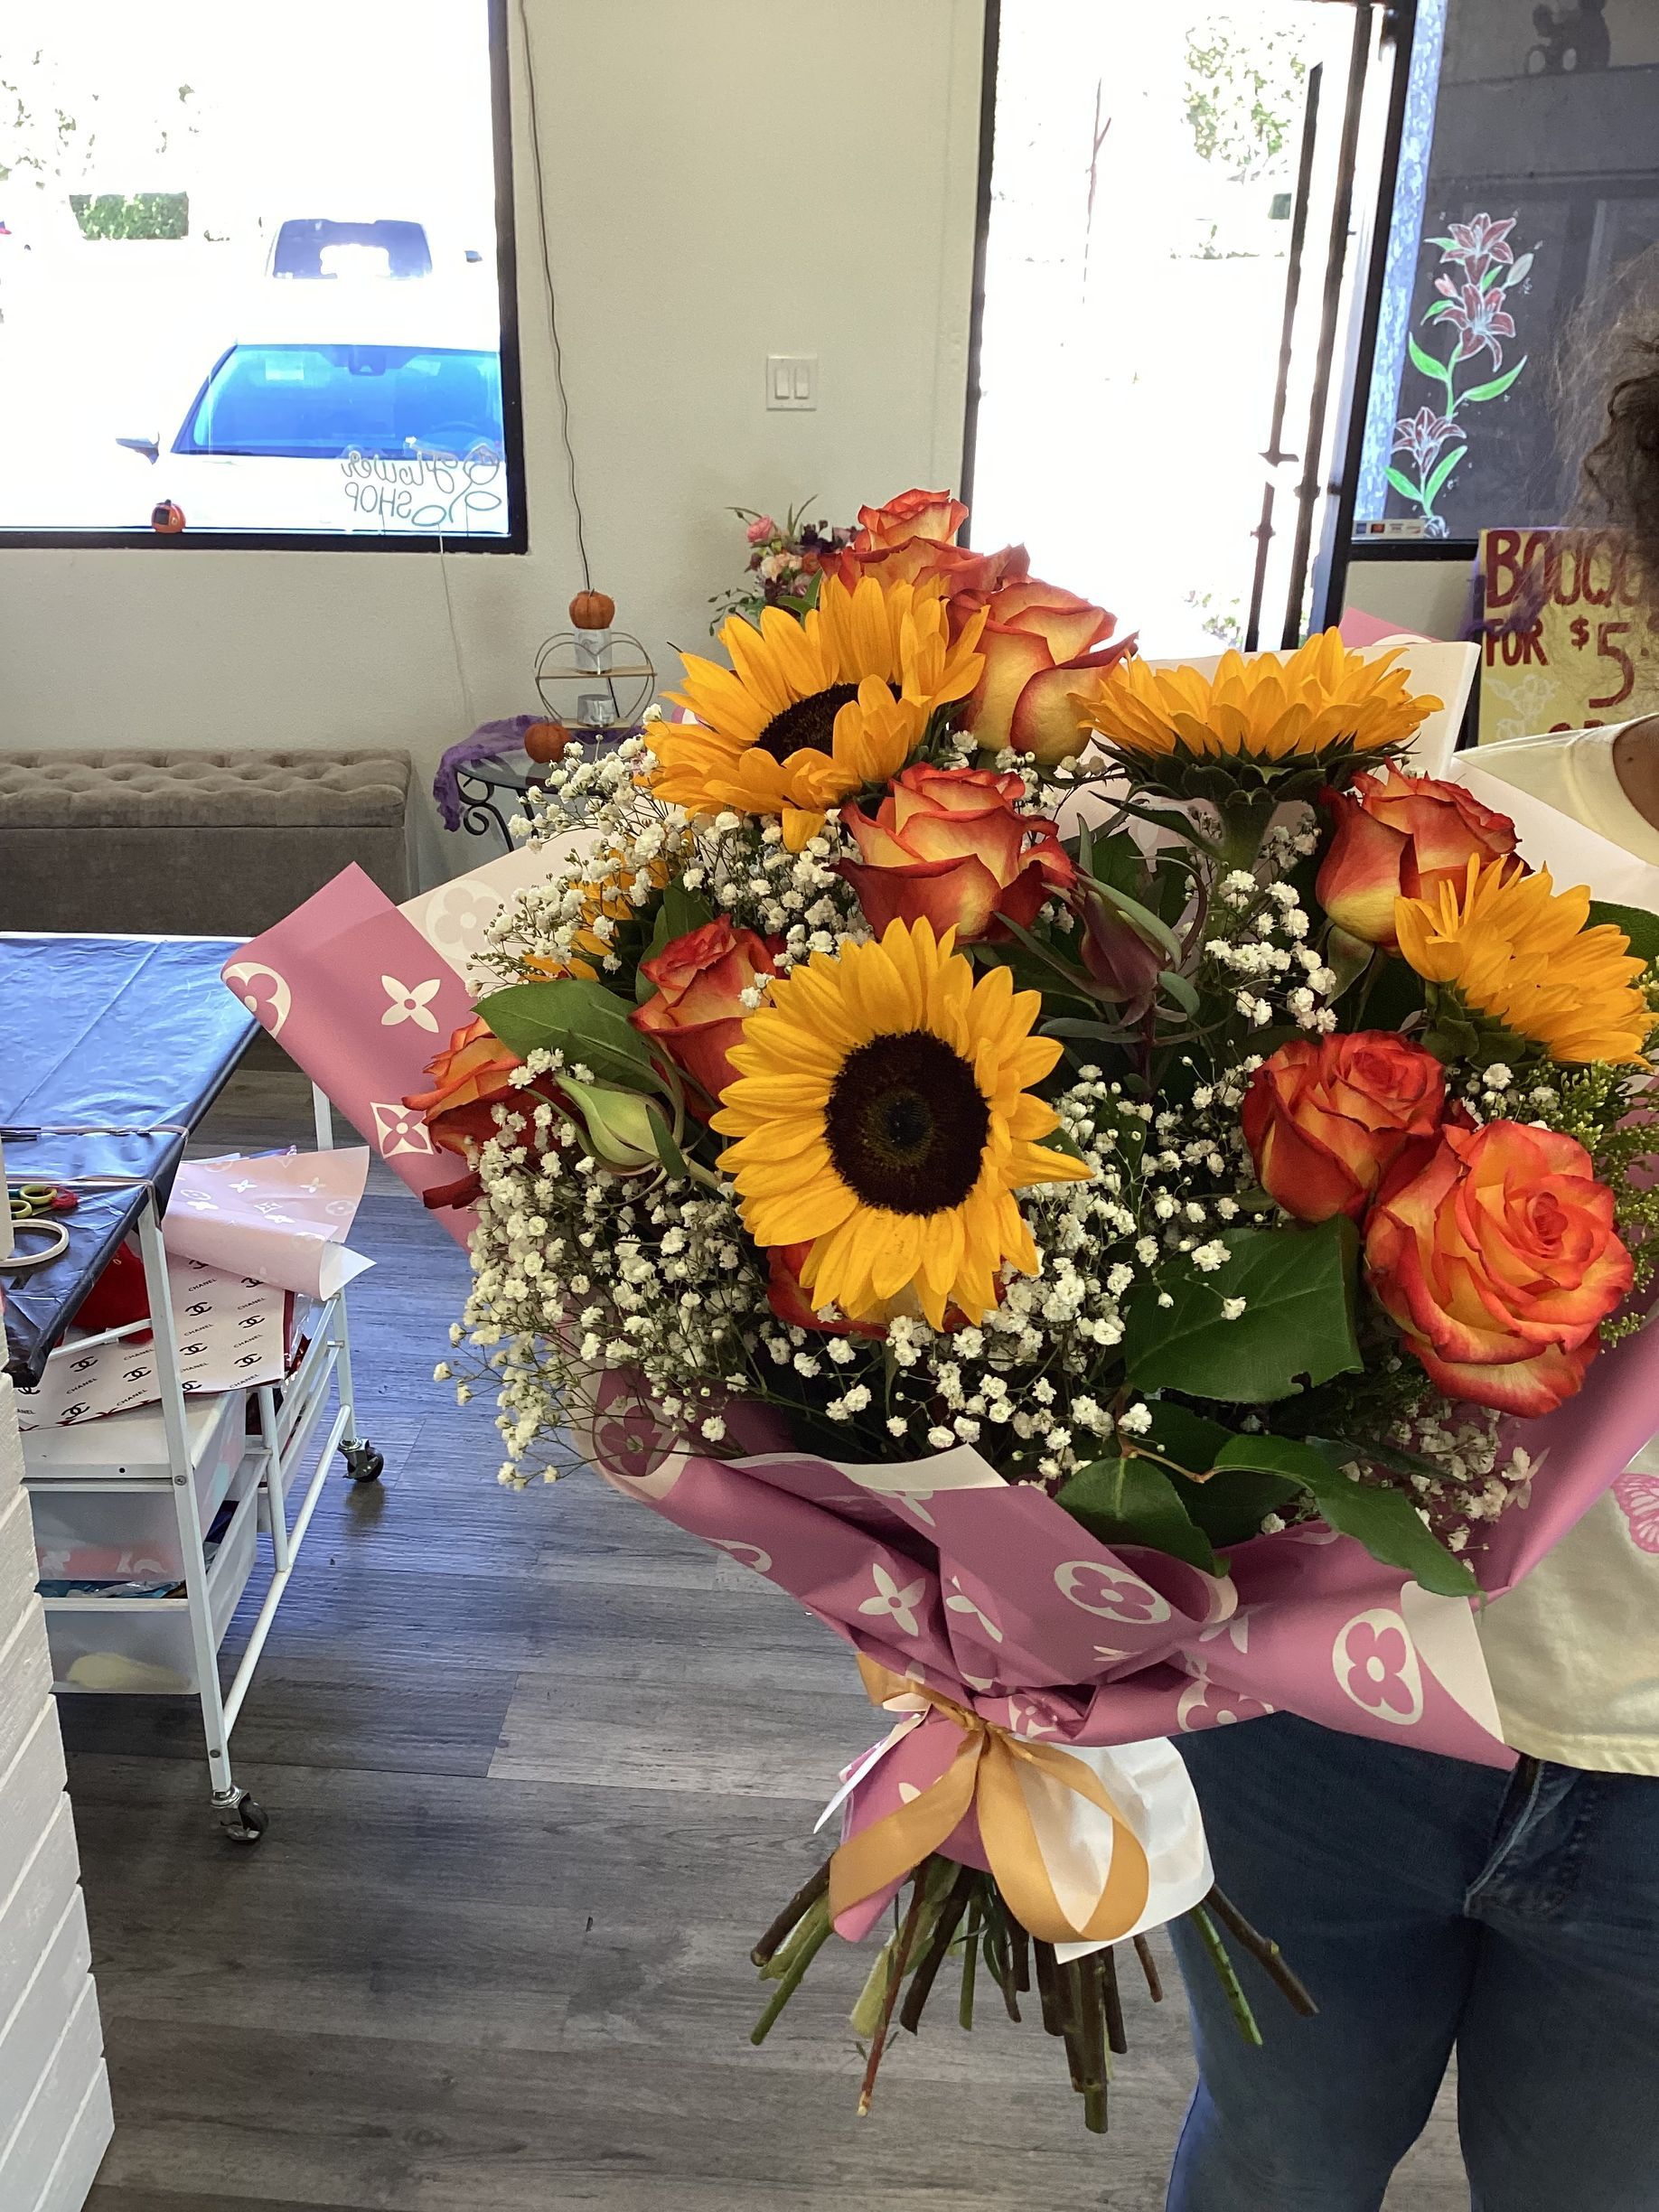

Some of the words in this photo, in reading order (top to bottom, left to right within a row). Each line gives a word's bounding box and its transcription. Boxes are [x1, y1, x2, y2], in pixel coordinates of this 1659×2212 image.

[1485, 618, 1550, 667] FOR
[188, 1279, 217, 1292] CHANEL
[237, 1297, 266, 1310] CHANEL
[183, 1324, 214, 1336] CHANEL
[233, 1334, 263, 1348] CHANEL
[124, 1348, 155, 1361] CHANEL
[66, 1378, 98, 1394] CHANEL
[230, 1373, 259, 1389] CHANEL
[116, 1389, 147, 1406] CHANEL
[16, 1408, 35, 1416] ANEL
